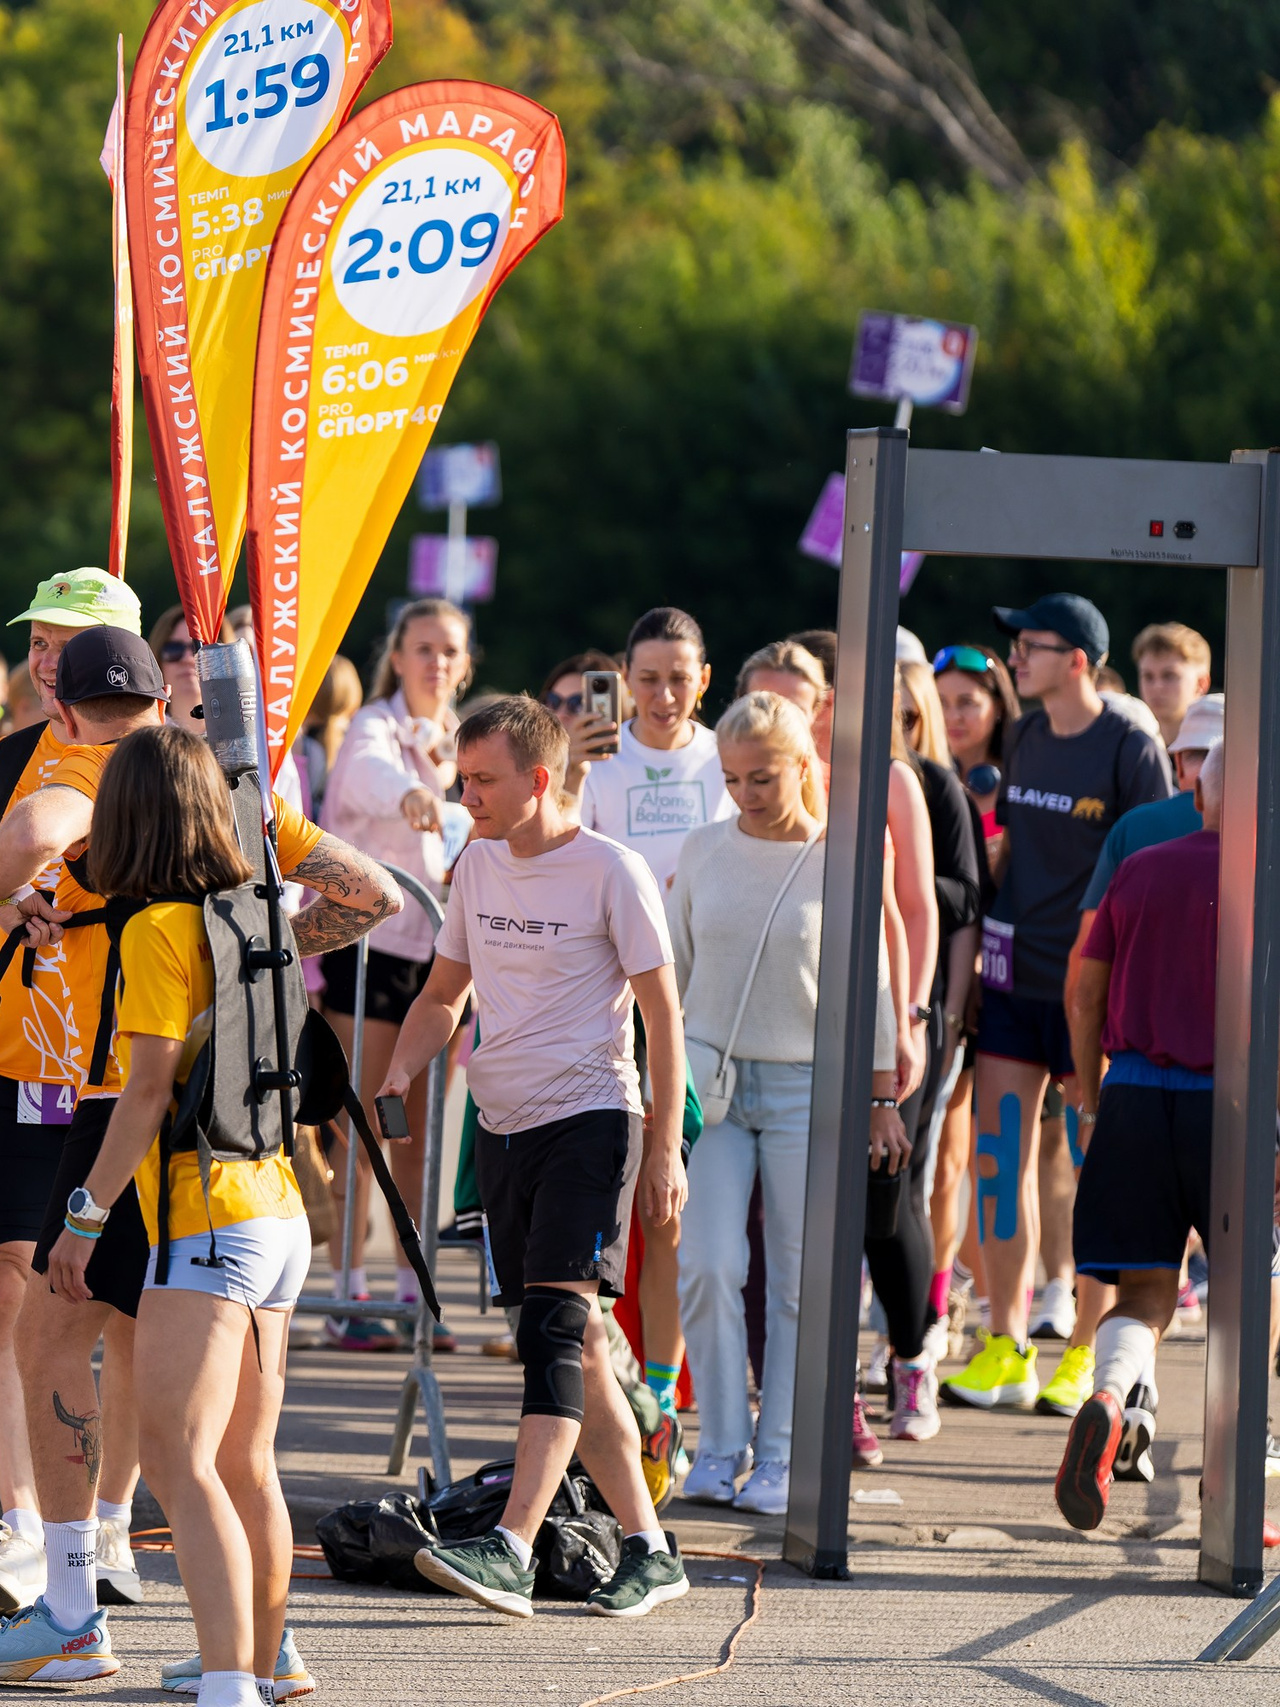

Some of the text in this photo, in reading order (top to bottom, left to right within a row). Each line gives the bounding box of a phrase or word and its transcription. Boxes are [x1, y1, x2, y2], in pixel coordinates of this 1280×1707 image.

[224, 24, 274, 57] 21,1
[205, 53, 330, 133] 1:59
[188, 186, 230, 206] ТЕМП
[382, 176, 436, 205] 21,1
[191, 197, 265, 240] 5:38
[192, 244, 223, 262] PRO
[342, 212, 500, 284] 2:09
[153, 0, 219, 576] КАЛУЖСКИЙ КОСМИЧЕСКИЙ
[279, 137, 383, 461] КОСМИЧЕСКИЙ
[323, 342, 369, 359] ТЕМП
[321, 356, 409, 395] 6:06
[318, 402, 353, 418] PRO
[266, 481, 302, 747] КАЛУЖСКИЙ
[639, 791, 696, 808] Aroma
[635, 806, 698, 823] Balance
[476, 913, 569, 936] TENET
[503, 940, 545, 951] ДВИЖЕНИЕМ
[61, 1632, 98, 1654] HOKA
